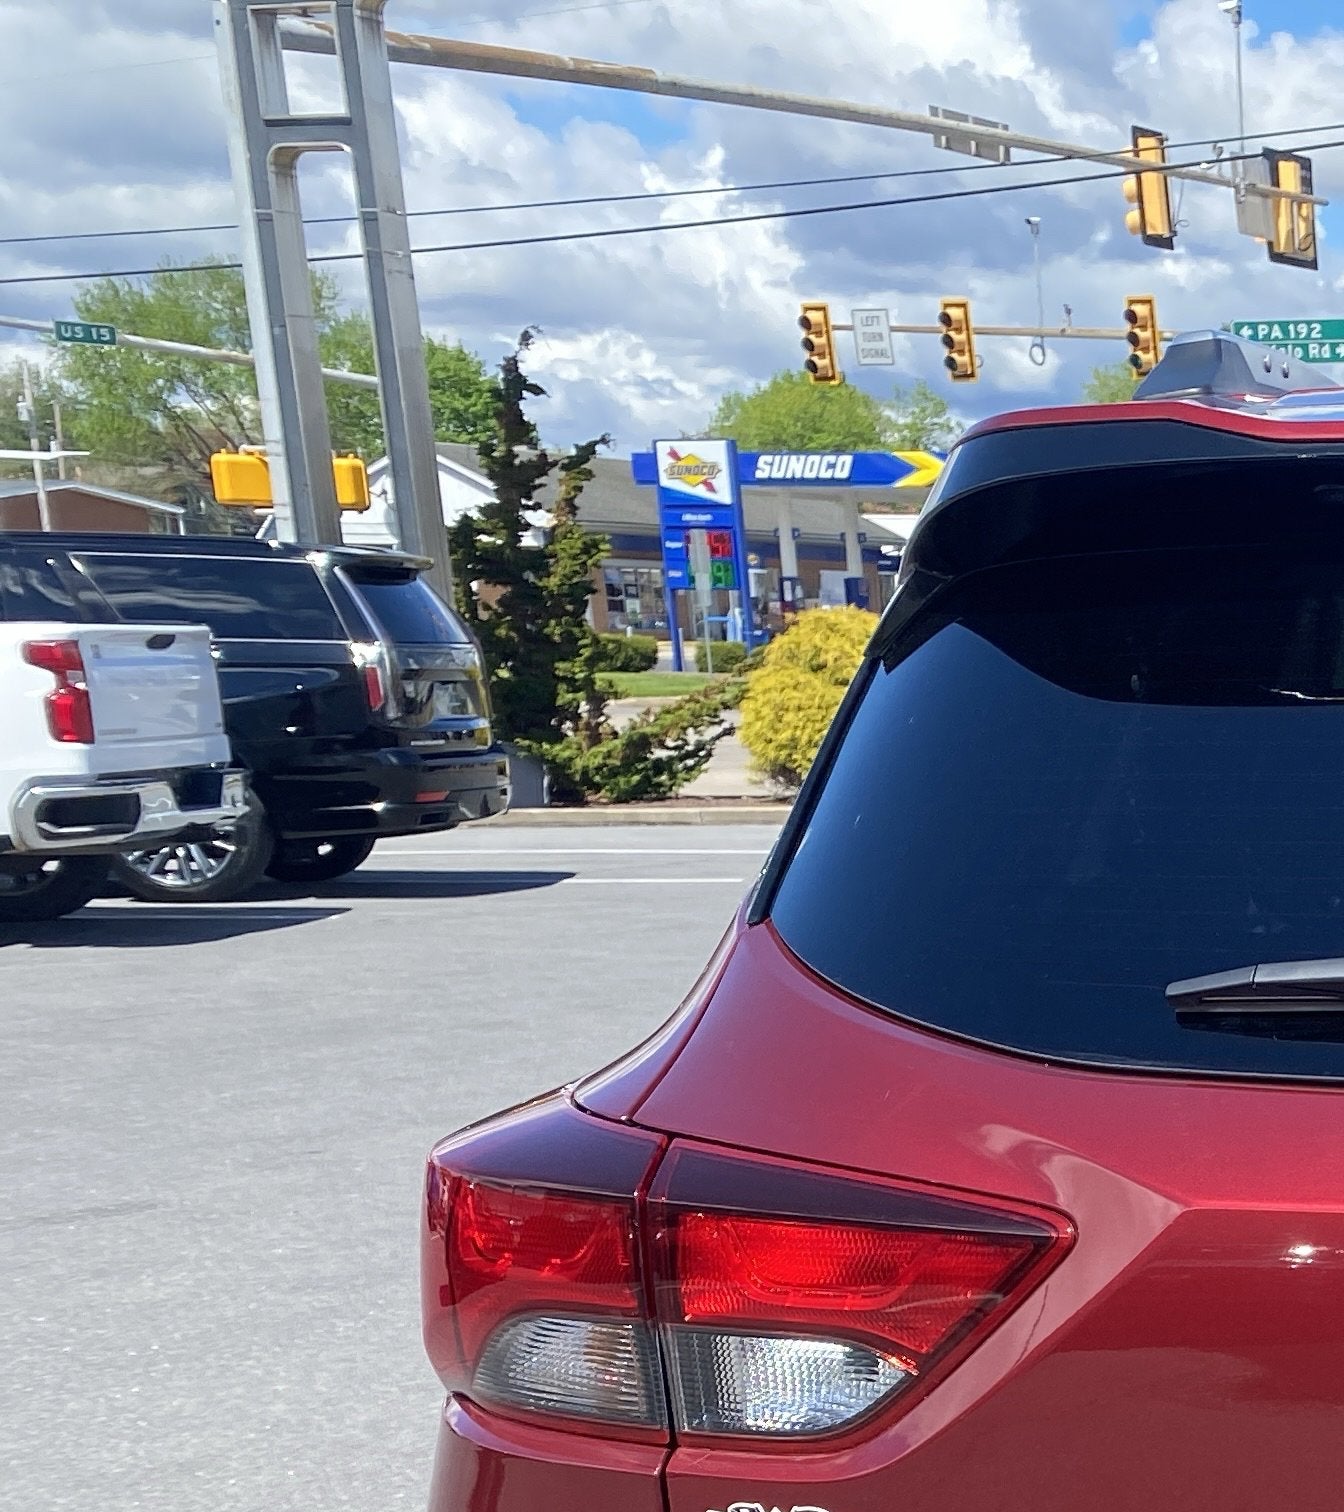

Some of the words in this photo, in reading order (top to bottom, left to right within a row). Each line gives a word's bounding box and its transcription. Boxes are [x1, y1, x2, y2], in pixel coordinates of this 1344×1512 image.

[61, 324, 84, 338] US
[91, 327, 111, 341] 15
[1257, 324, 1283, 339] PA
[1288, 323, 1322, 339] 192
[1308, 343, 1331, 359] Rd
[668, 463, 716, 477] SUNOCO
[755, 454, 853, 479] SUNOCO
